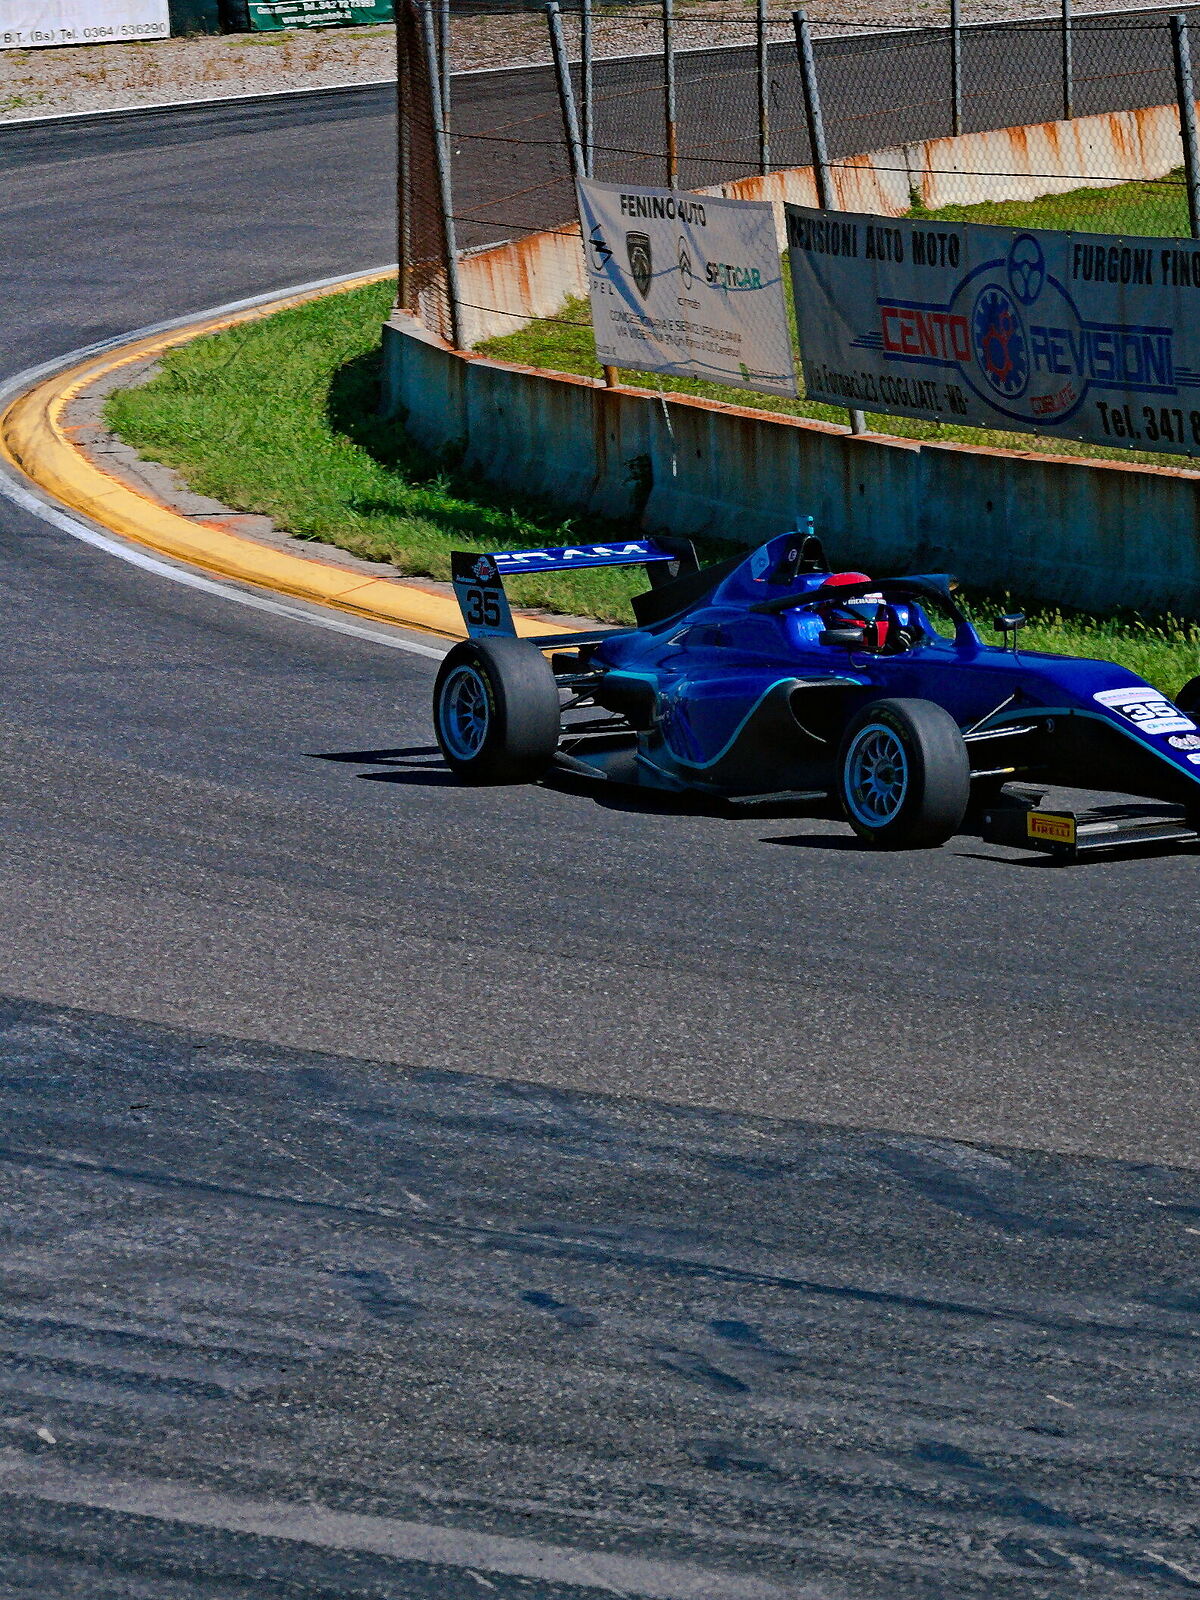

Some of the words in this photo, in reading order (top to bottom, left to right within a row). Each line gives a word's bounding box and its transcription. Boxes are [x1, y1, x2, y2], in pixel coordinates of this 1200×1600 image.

[31, 29, 54, 42] (Bs)
[60, 28, 78, 40] Tel.
[865, 225, 904, 263] AUTO
[912, 231, 960, 268] MOTO
[1072, 244, 1152, 285] FURGONI
[589, 279, 614, 296] PEL
[881, 306, 972, 362] CENTO
[1030, 326, 1174, 385] REVISIONI
[879, 375, 943, 411] COGLIATE
[1097, 401, 1141, 439] Tel.
[1143, 406, 1184, 444] 347
[467, 589, 500, 627] 35
[1122, 702, 1178, 721] 35
[1032, 818, 1070, 838] PIRELLI
